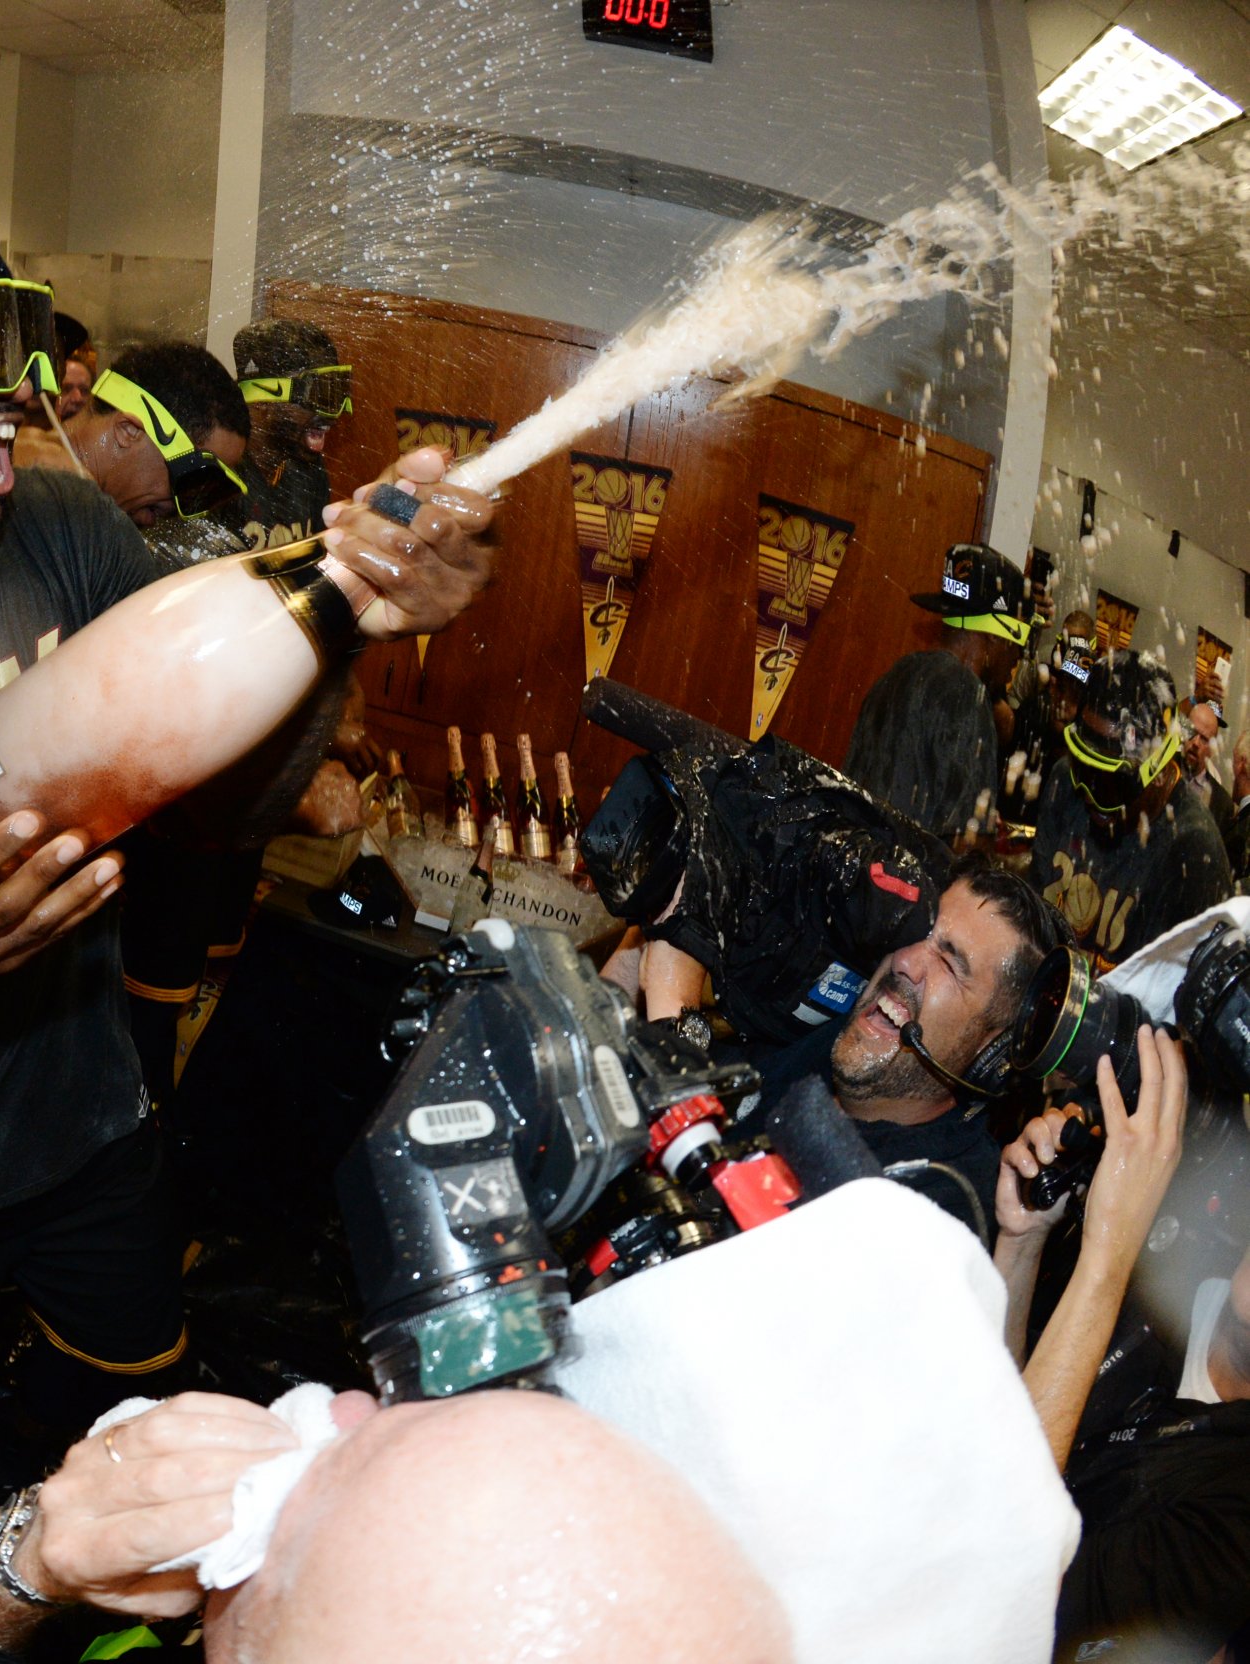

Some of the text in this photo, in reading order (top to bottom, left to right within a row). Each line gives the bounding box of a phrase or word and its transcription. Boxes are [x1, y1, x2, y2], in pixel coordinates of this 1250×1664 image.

[572, 463, 667, 513] 2016
[758, 507, 848, 567] 2016
[1097, 597, 1134, 634] 2016
[492, 887, 582, 927] CHANDON
[1043, 850, 1134, 953] 2016
[1099, 1349, 1124, 1375] 2016
[1108, 1428, 1137, 1442] 2016
